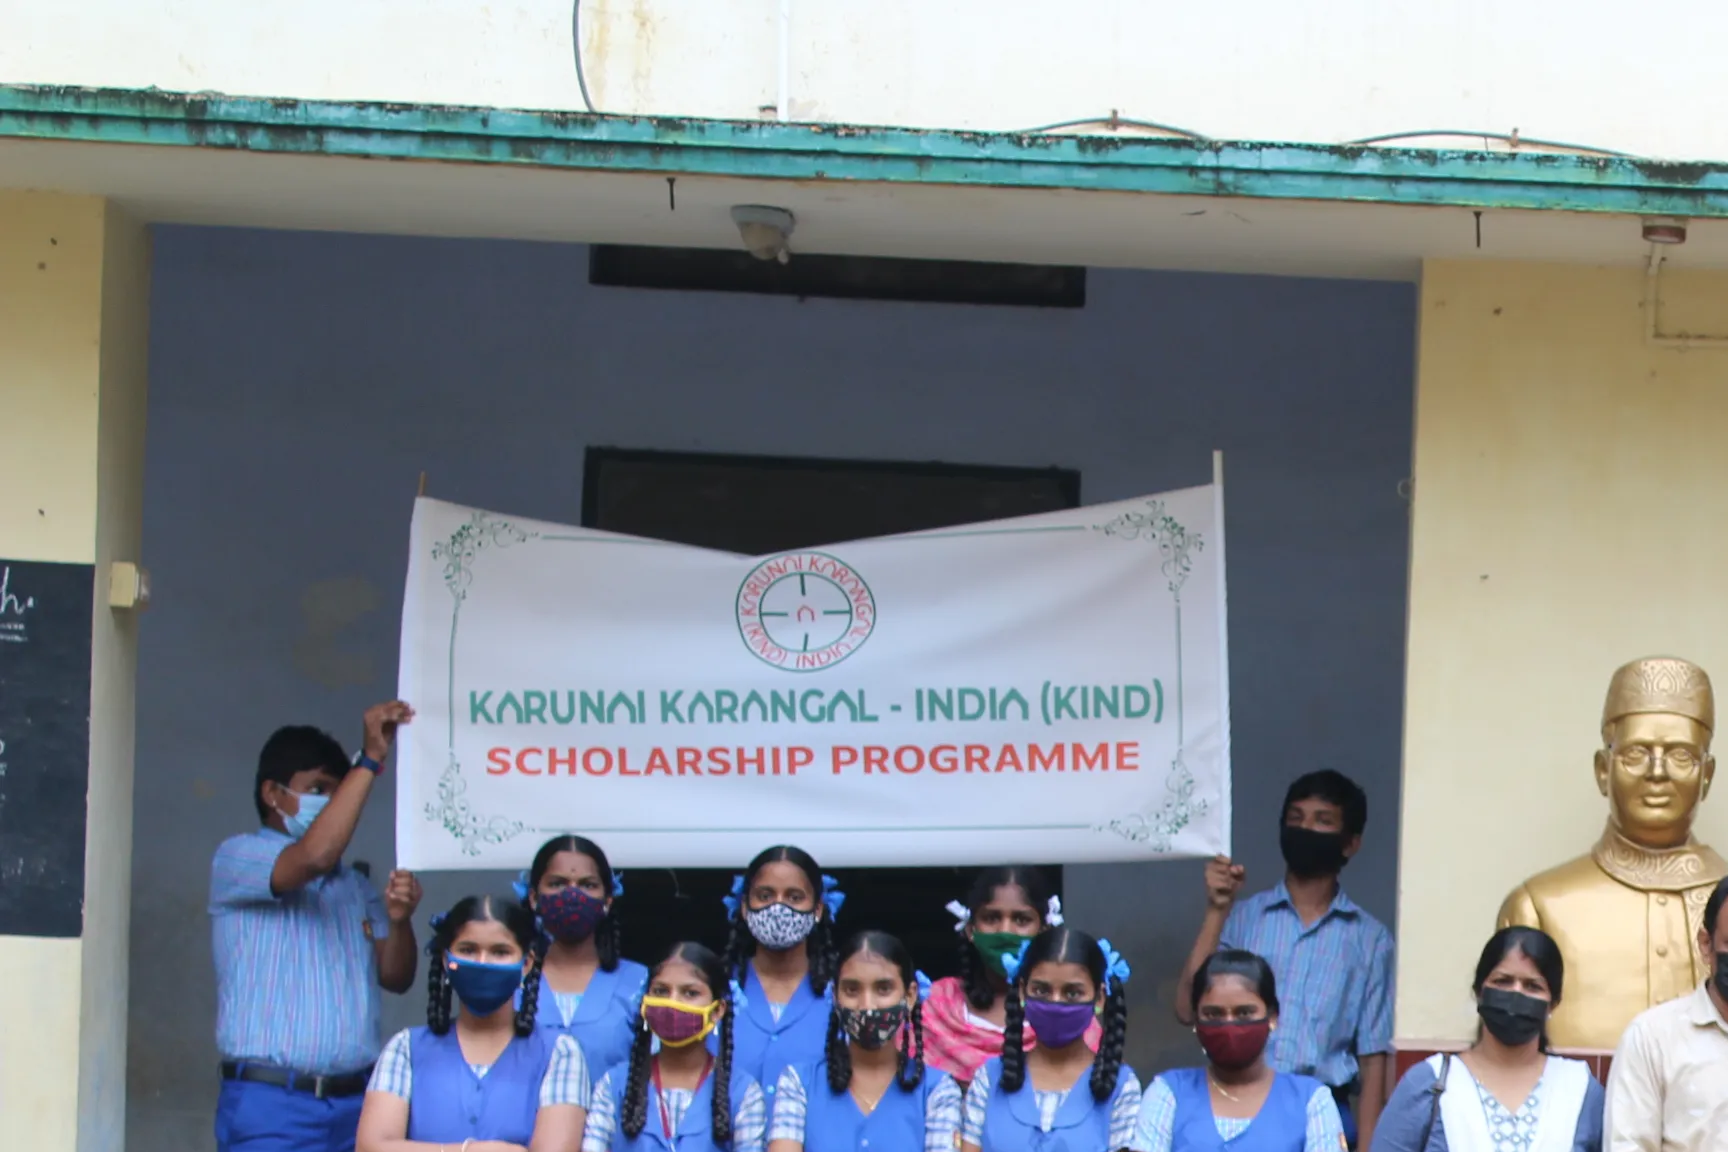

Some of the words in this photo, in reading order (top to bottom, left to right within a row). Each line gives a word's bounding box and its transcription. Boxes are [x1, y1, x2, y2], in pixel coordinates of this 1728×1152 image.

[741, 554, 803, 617] KARUNAI
[469, 689, 646, 725] KARUNAI
[659, 688, 879, 724] KARANGAL
[915, 686, 1029, 722] INDIA
[1041, 678, 1164, 726] (KIND)
[486, 746, 815, 777] SCHOLARSHIP
[831, 741, 1140, 775] PROGRAMME
